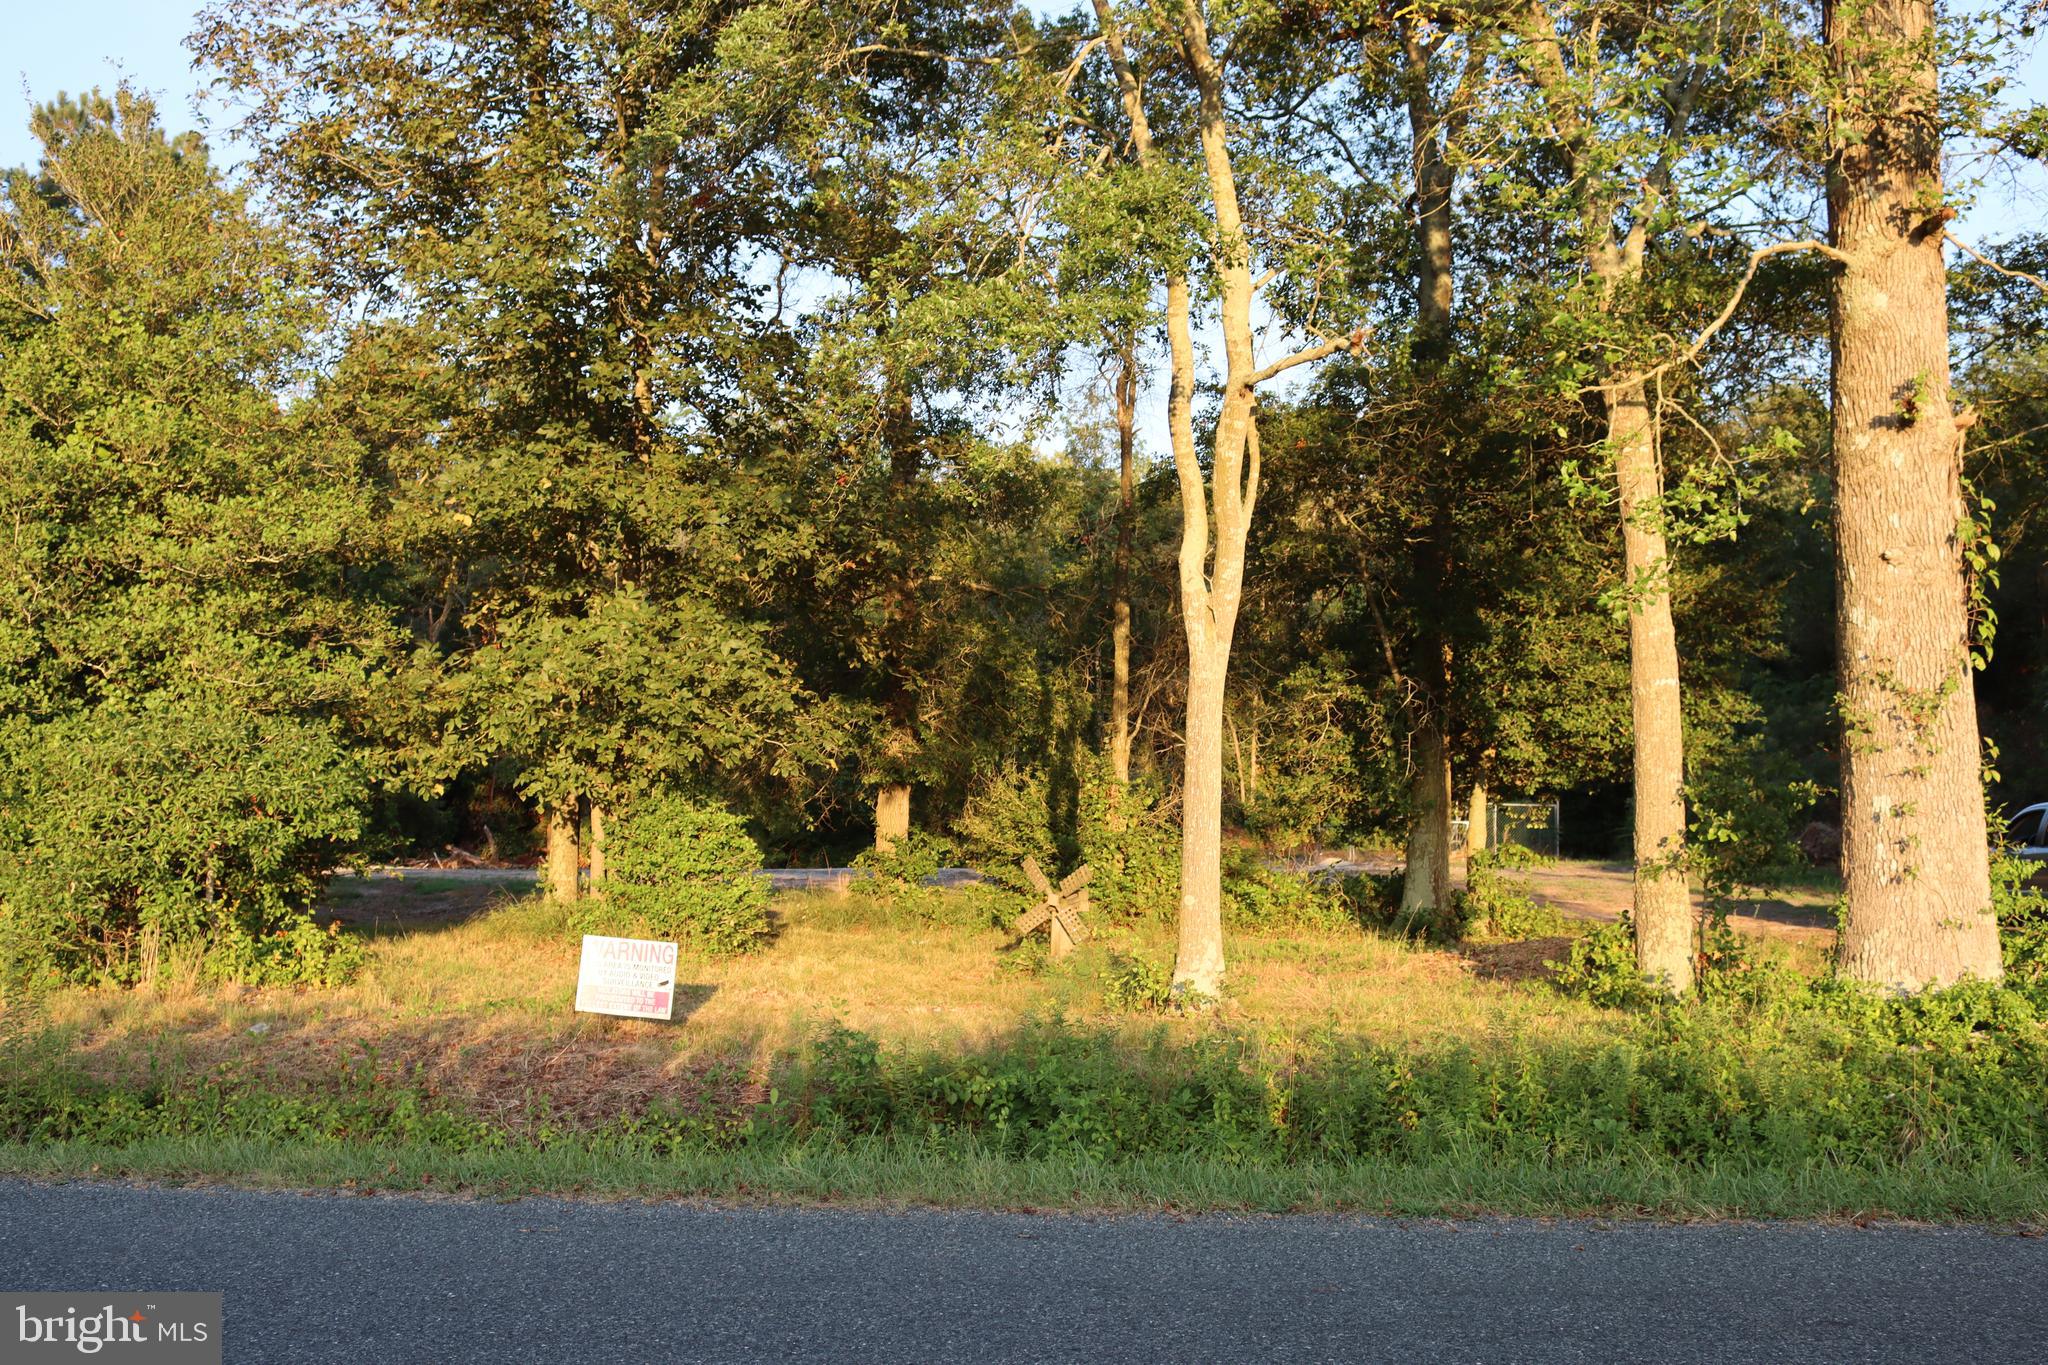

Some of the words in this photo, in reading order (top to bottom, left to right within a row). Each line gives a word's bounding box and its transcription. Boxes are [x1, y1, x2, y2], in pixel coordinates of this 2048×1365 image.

[632, 963, 672, 974] MONITORED
[608, 970, 631, 978] AUDIO
[639, 973, 659, 981] VIDEO
